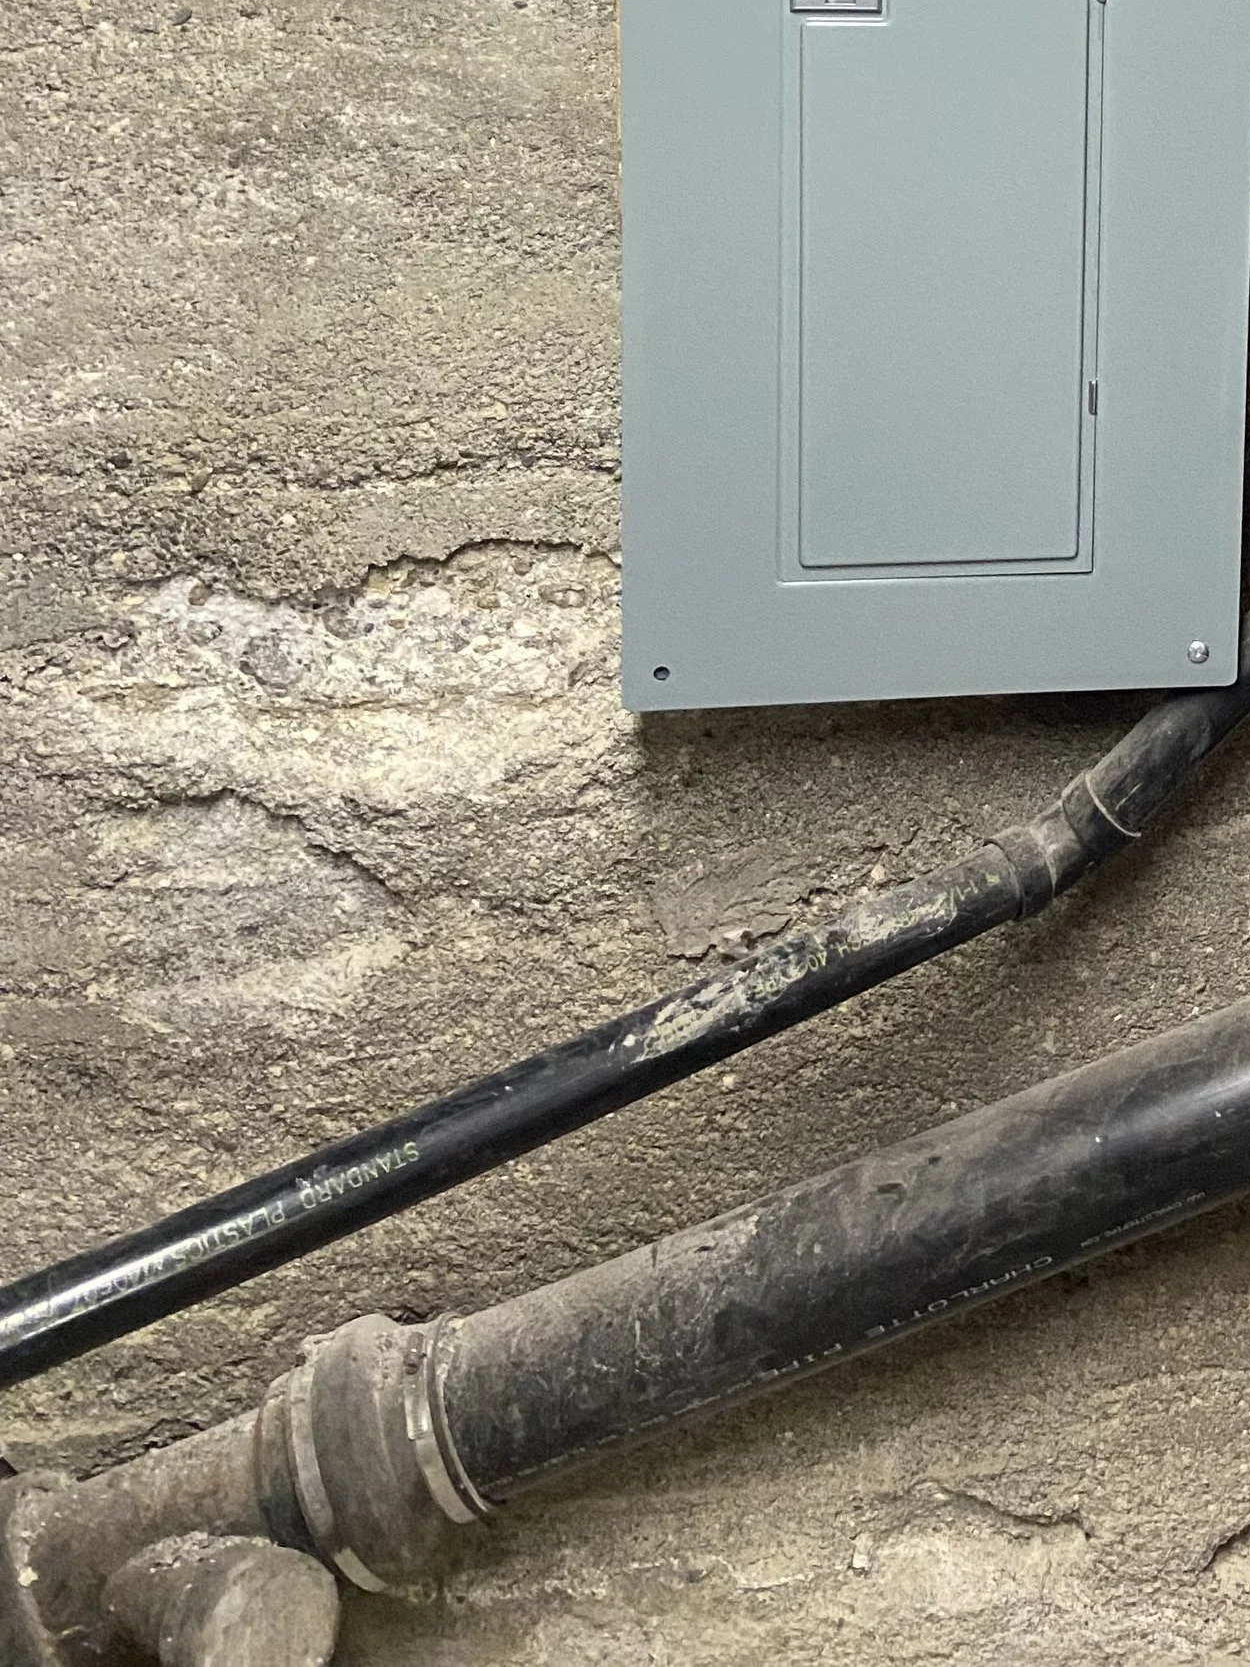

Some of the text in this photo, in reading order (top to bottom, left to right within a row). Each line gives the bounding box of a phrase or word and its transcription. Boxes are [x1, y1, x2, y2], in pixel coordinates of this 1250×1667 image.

[805, 948, 829, 972] 40
[300, 1142, 419, 1209] STANDARD
[171, 1200, 285, 1269] PLASTICS
[864, 1255, 1052, 1338] CHARLOTTE
[760, 1342, 843, 1380] PIPE
